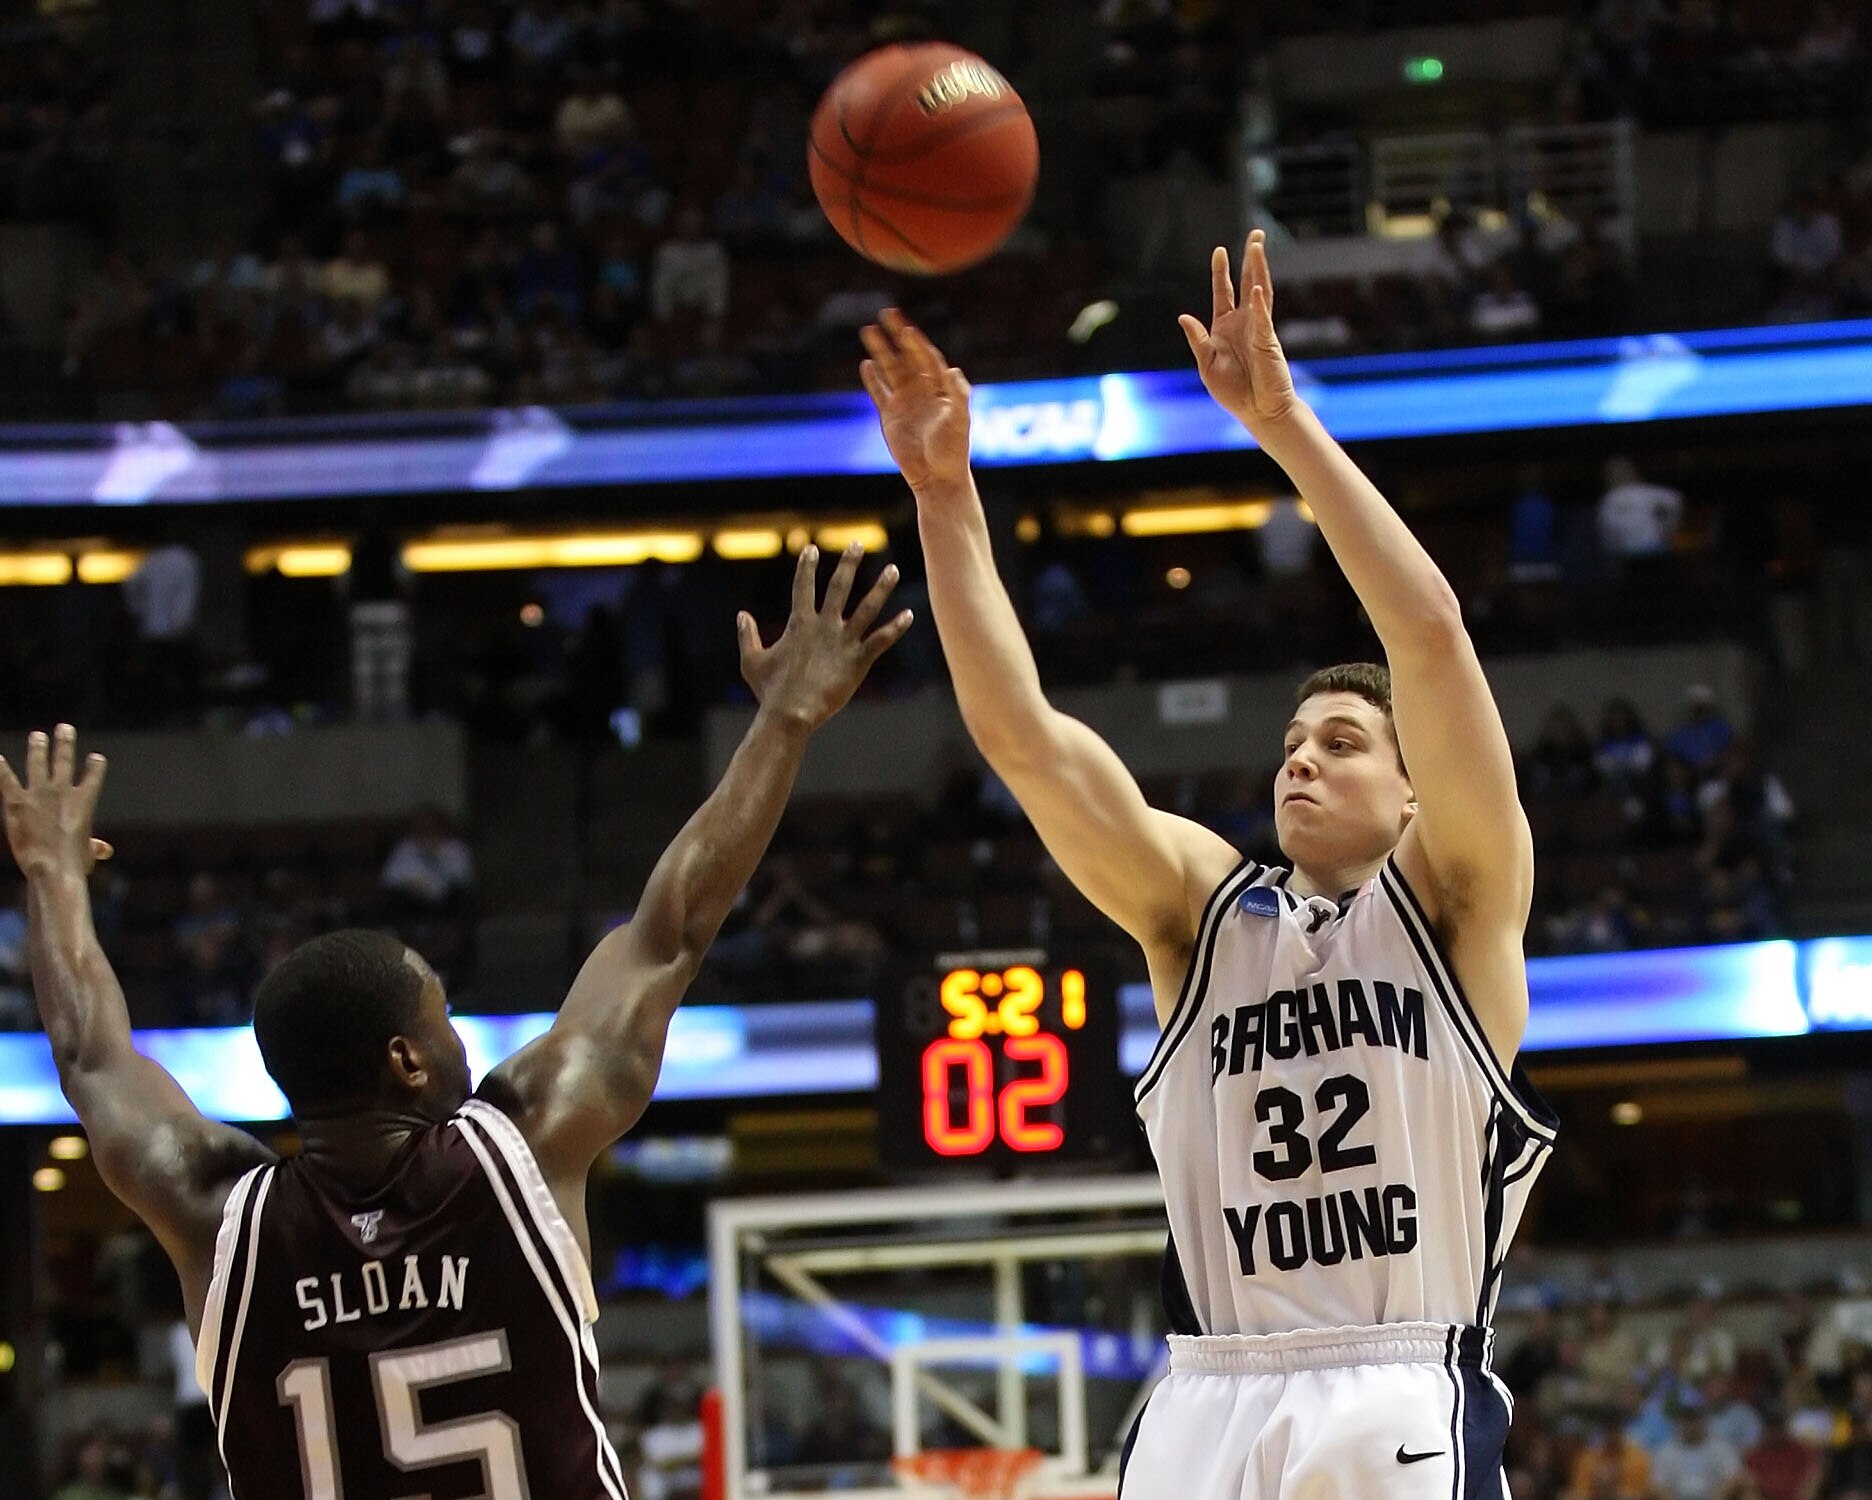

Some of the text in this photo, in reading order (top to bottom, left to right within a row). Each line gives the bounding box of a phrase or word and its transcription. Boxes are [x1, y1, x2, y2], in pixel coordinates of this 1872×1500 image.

[1246, 901, 1278, 914] NCAA
[1306, 903, 1332, 934] Y
[940, 966, 1087, 1040] 5:21
[1212, 979, 1429, 1088] BRGHAM
[922, 1033, 1069, 1156] 02
[1252, 1073, 1376, 1182] 32
[1223, 1183, 1418, 1276] YOUNG
[295, 1254, 470, 1331] SLOAN
